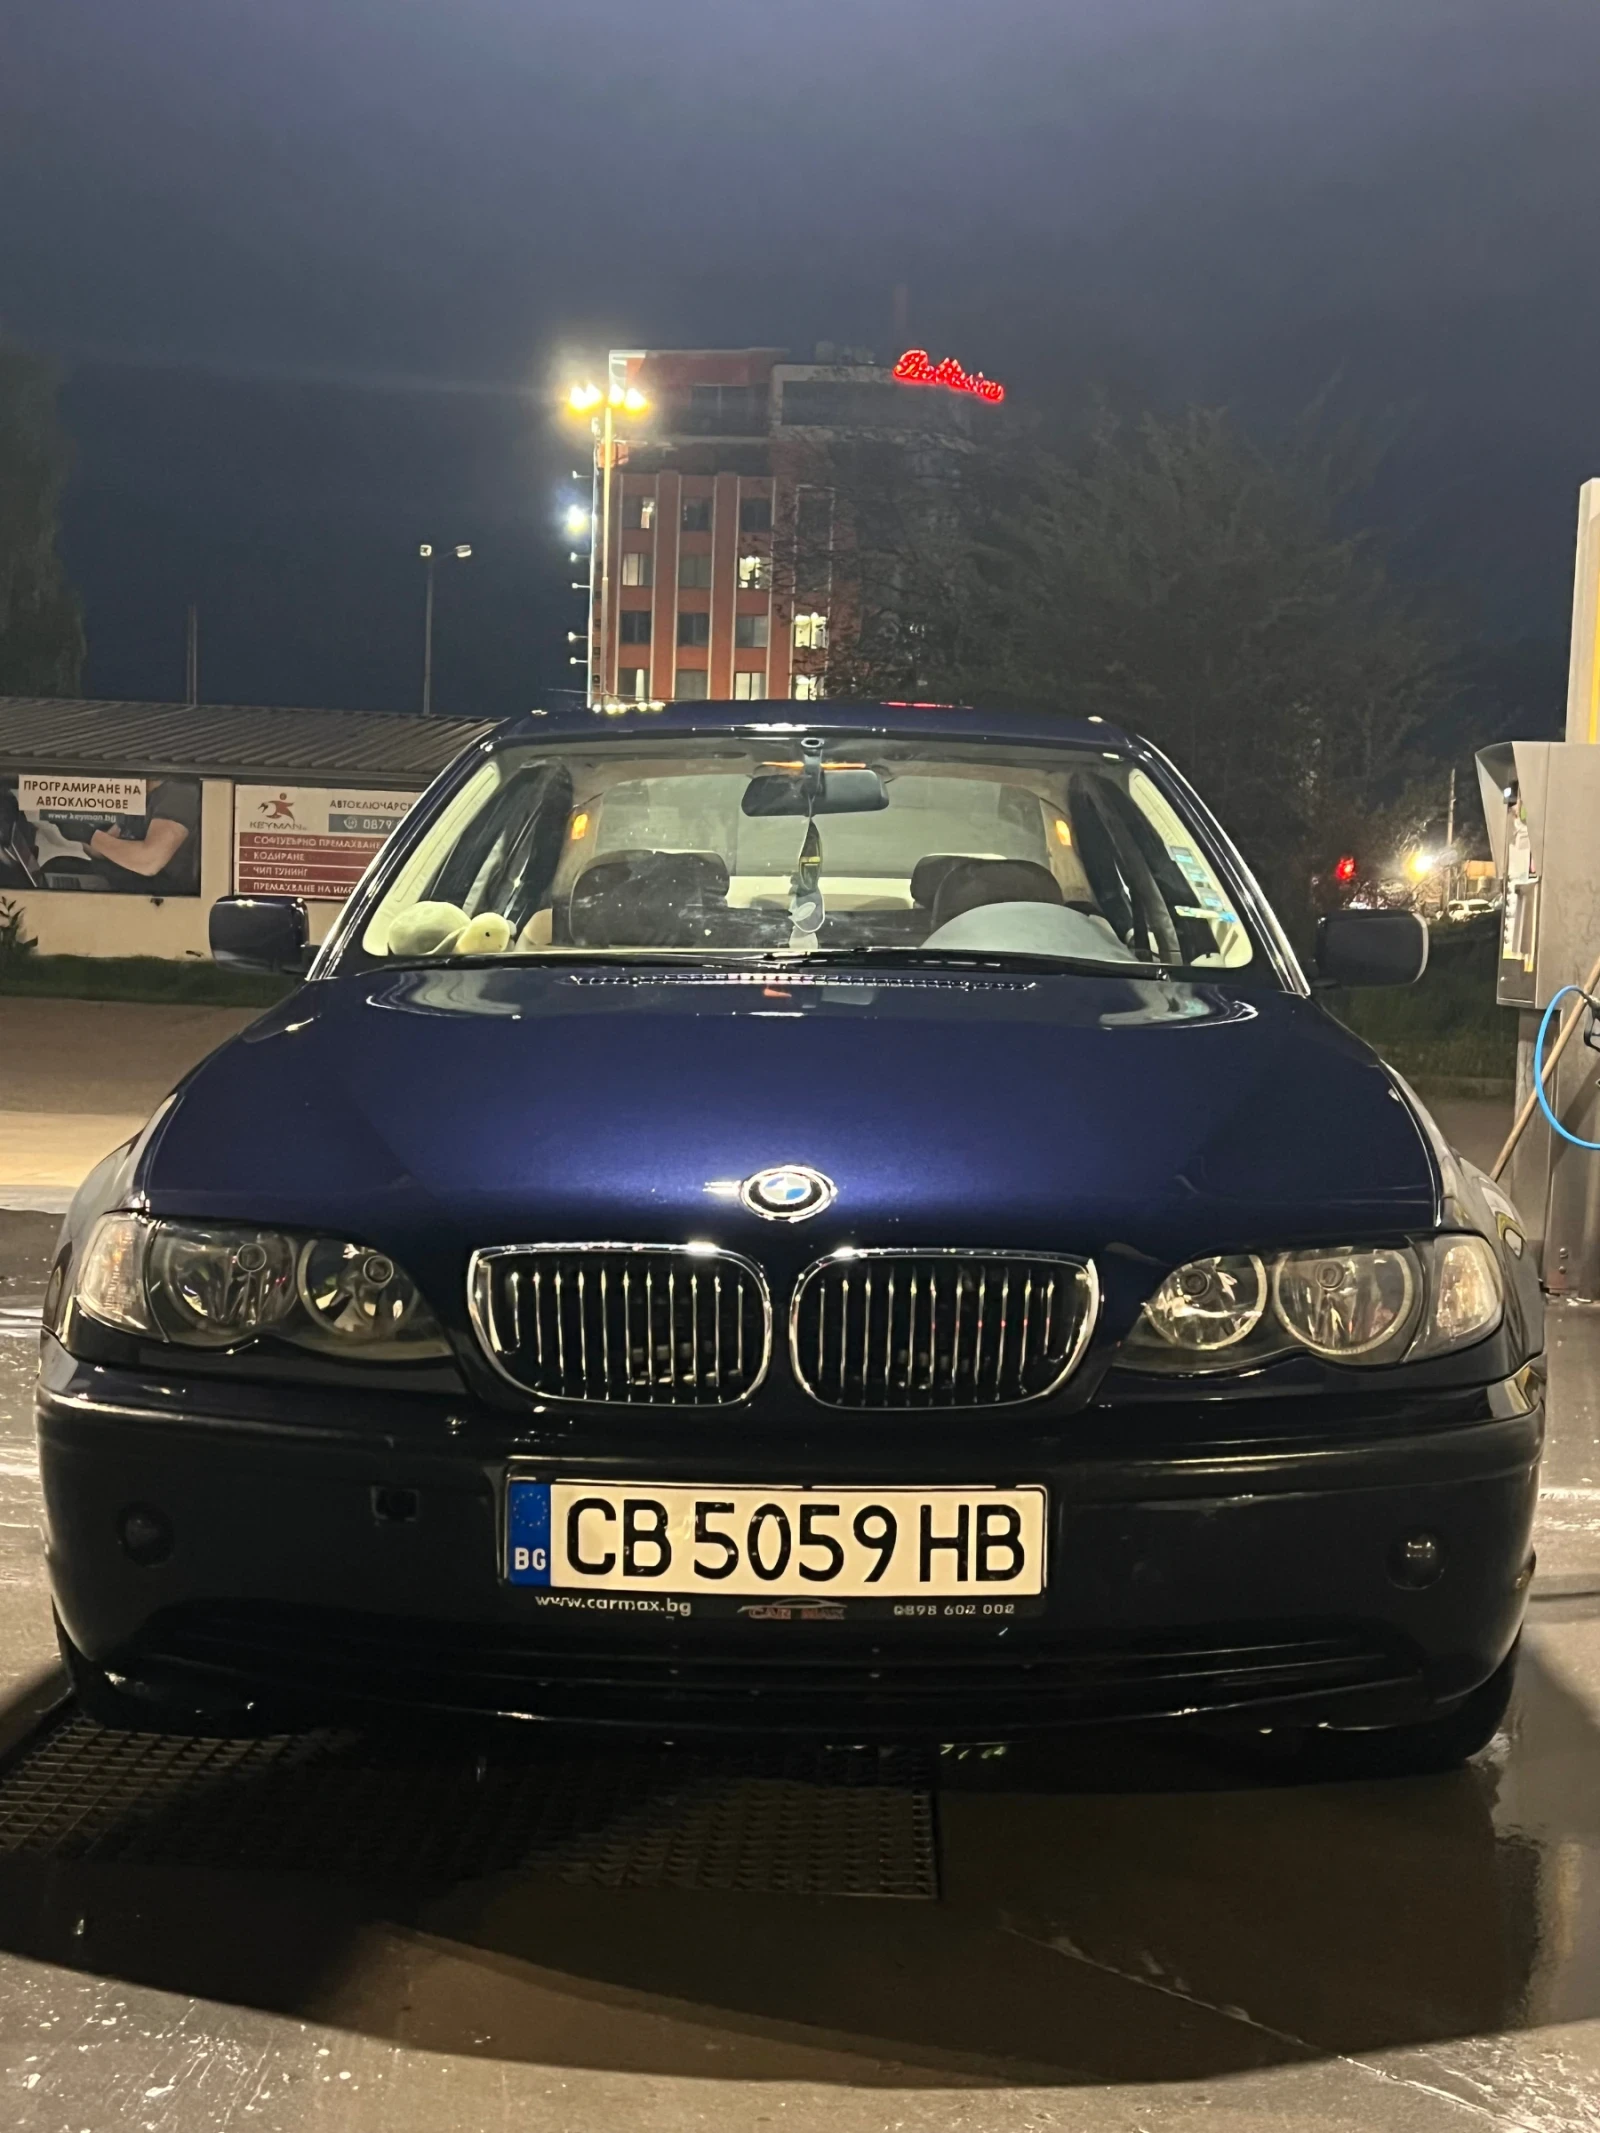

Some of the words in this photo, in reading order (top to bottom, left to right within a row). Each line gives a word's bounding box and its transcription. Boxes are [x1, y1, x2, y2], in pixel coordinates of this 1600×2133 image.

[23, 780, 121, 795] ПРОГРАМИРАНЕ
[124, 785, 142, 795] НА
[36, 796, 129, 809] АВТОКЛЮЧОВЕ
[249, 821, 302, 830] KEYMAN
[253, 851, 305, 861] КОДИРАНЕ
[253, 867, 272, 875] ЧИП
[275, 867, 308, 877] ТУНИНГ
[253, 882, 316, 893] ПРЕМАХВАНЕ
[567, 1497, 672, 1577] CB
[693, 1501, 898, 1583] 5059
[919, 1504, 1025, 1582] HB
[514, 1547, 546, 1570] BG
[535, 1596, 692, 1617] www.carmax.bg
[944, 1605, 976, 1616] 602
